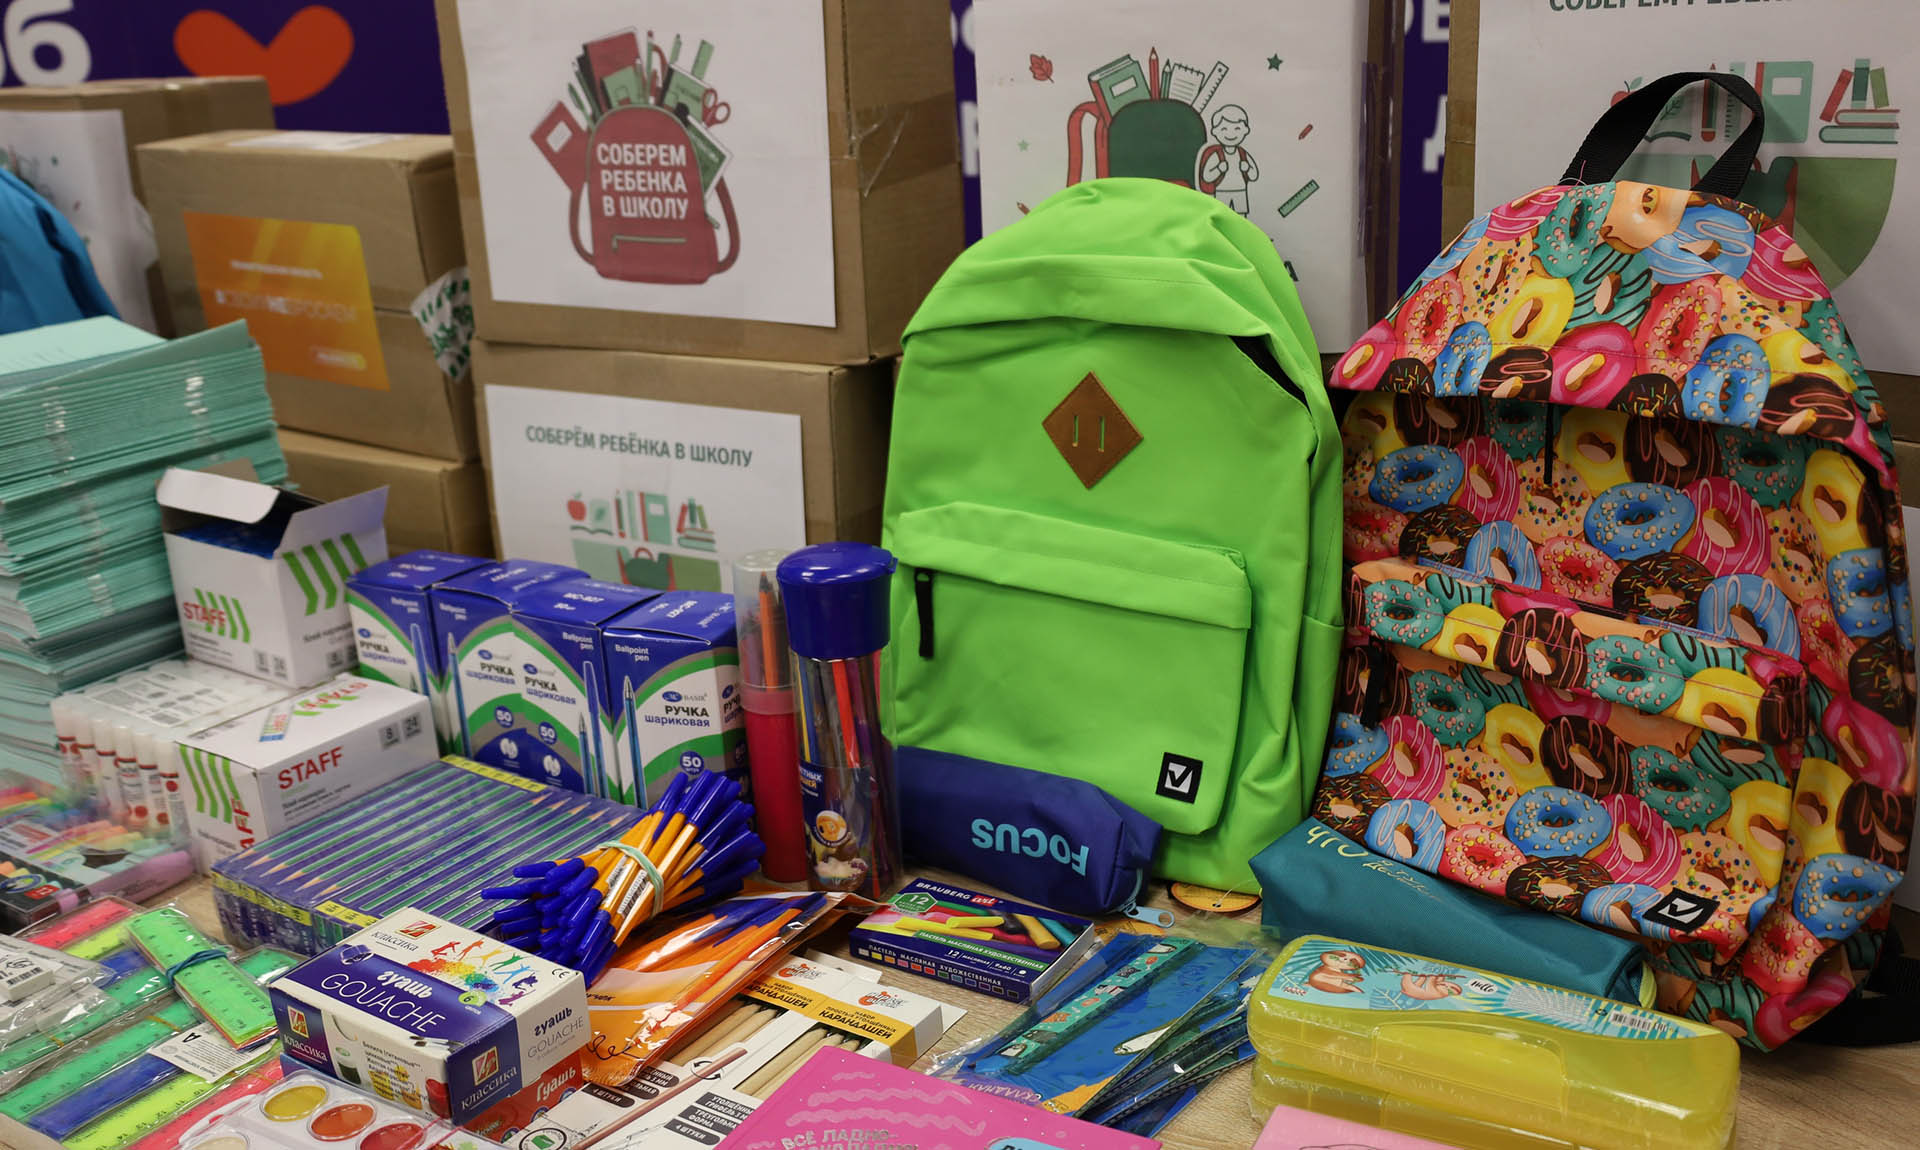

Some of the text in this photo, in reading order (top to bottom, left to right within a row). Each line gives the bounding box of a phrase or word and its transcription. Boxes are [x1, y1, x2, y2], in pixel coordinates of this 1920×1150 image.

[596, 143, 687, 167] СОБЕРЕМ
[601, 170, 688, 193] РЕБЕНКА
[603, 195, 689, 220] В ШКОЛУ
[526, 425, 753, 467] СОБЕРЁМ РЕБЁНКА В ШКОЛУ
[183, 601, 226, 627] STAFF
[359, 640, 390, 654] РУЧКА
[615, 644, 650, 657] Ballpoint
[635, 653, 650, 663] pen
[480, 661, 514, 677] РУЧКА
[524, 675, 558, 693] РУЧКА
[526, 686, 577, 705] шариковая
[495, 708, 512, 723] 50
[645, 713, 710, 728] шариковая
[665, 704, 710, 718] РУЧКА
[540, 724, 556, 739] 50
[278, 746, 343, 790] STAFF
[682, 756, 702, 768] 50
[971, 818, 1090, 877] FOCUS
[908, 894, 930, 906] 12
[916, 881, 996, 905] BRAUBERG art
[370, 930, 419, 953] классика
[919, 930, 1044, 970] ПАСТЕЛЬ МАСЛЯНАЯ ХУДОЖЕСТВЕННАЯ
[947, 949, 960, 958] 12
[868, 944, 1002, 987] ПАСТЕЛЬ МАСЛЯНАЯ ХУДОЖЕСТВЕННАЯ
[376, 970, 433, 999] гуашь
[1471, 979, 1495, 993] Hello
[320, 973, 447, 1033] GOUACHE
[533, 1007, 573, 1037] гуашь
[818, 1009, 893, 1039] КАРАНДАШЕЙ
[283, 1032, 329, 1062] классика
[527, 1016, 585, 1059] GOUACHE
[460, 1065, 519, 1111] классика
[536, 1066, 578, 1103] Гуашь
[599, 1090, 622, 1103] ШТУКИ
[695, 1109, 738, 1129] ТРЕУГОЛЬНА
[704, 1101, 735, 1117] ГРИФЕЛЬ
[688, 1114, 714, 1128] ФОРМА
[682, 1126, 706, 1140] ШТУКИ
